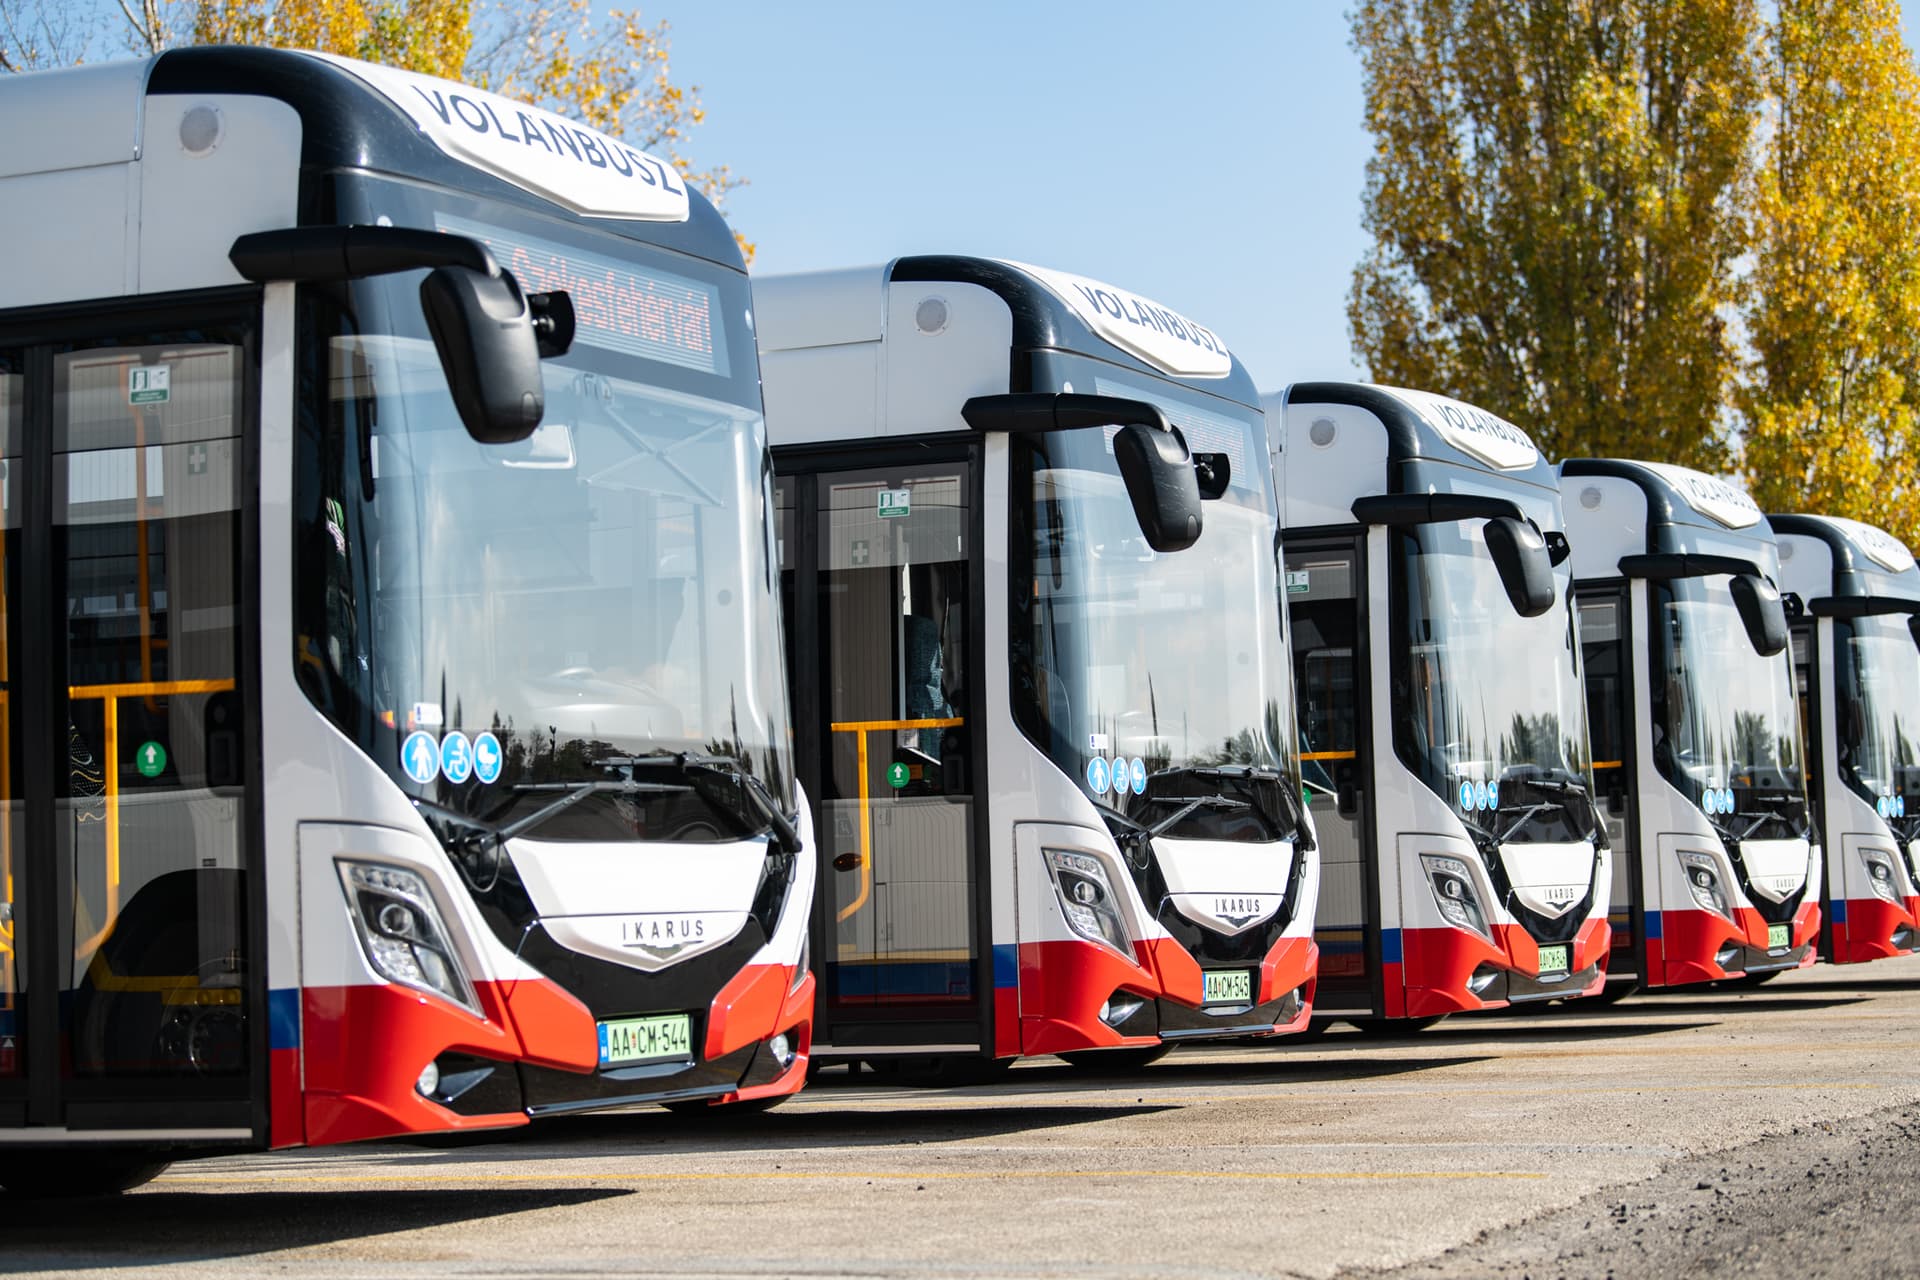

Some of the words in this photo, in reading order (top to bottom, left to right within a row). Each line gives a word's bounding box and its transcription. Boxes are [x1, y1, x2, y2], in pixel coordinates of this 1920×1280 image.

[1544, 887, 1574, 900] IKARUS
[1215, 898, 1260, 913] IKARUS
[622, 919, 704, 941] IKARUS
